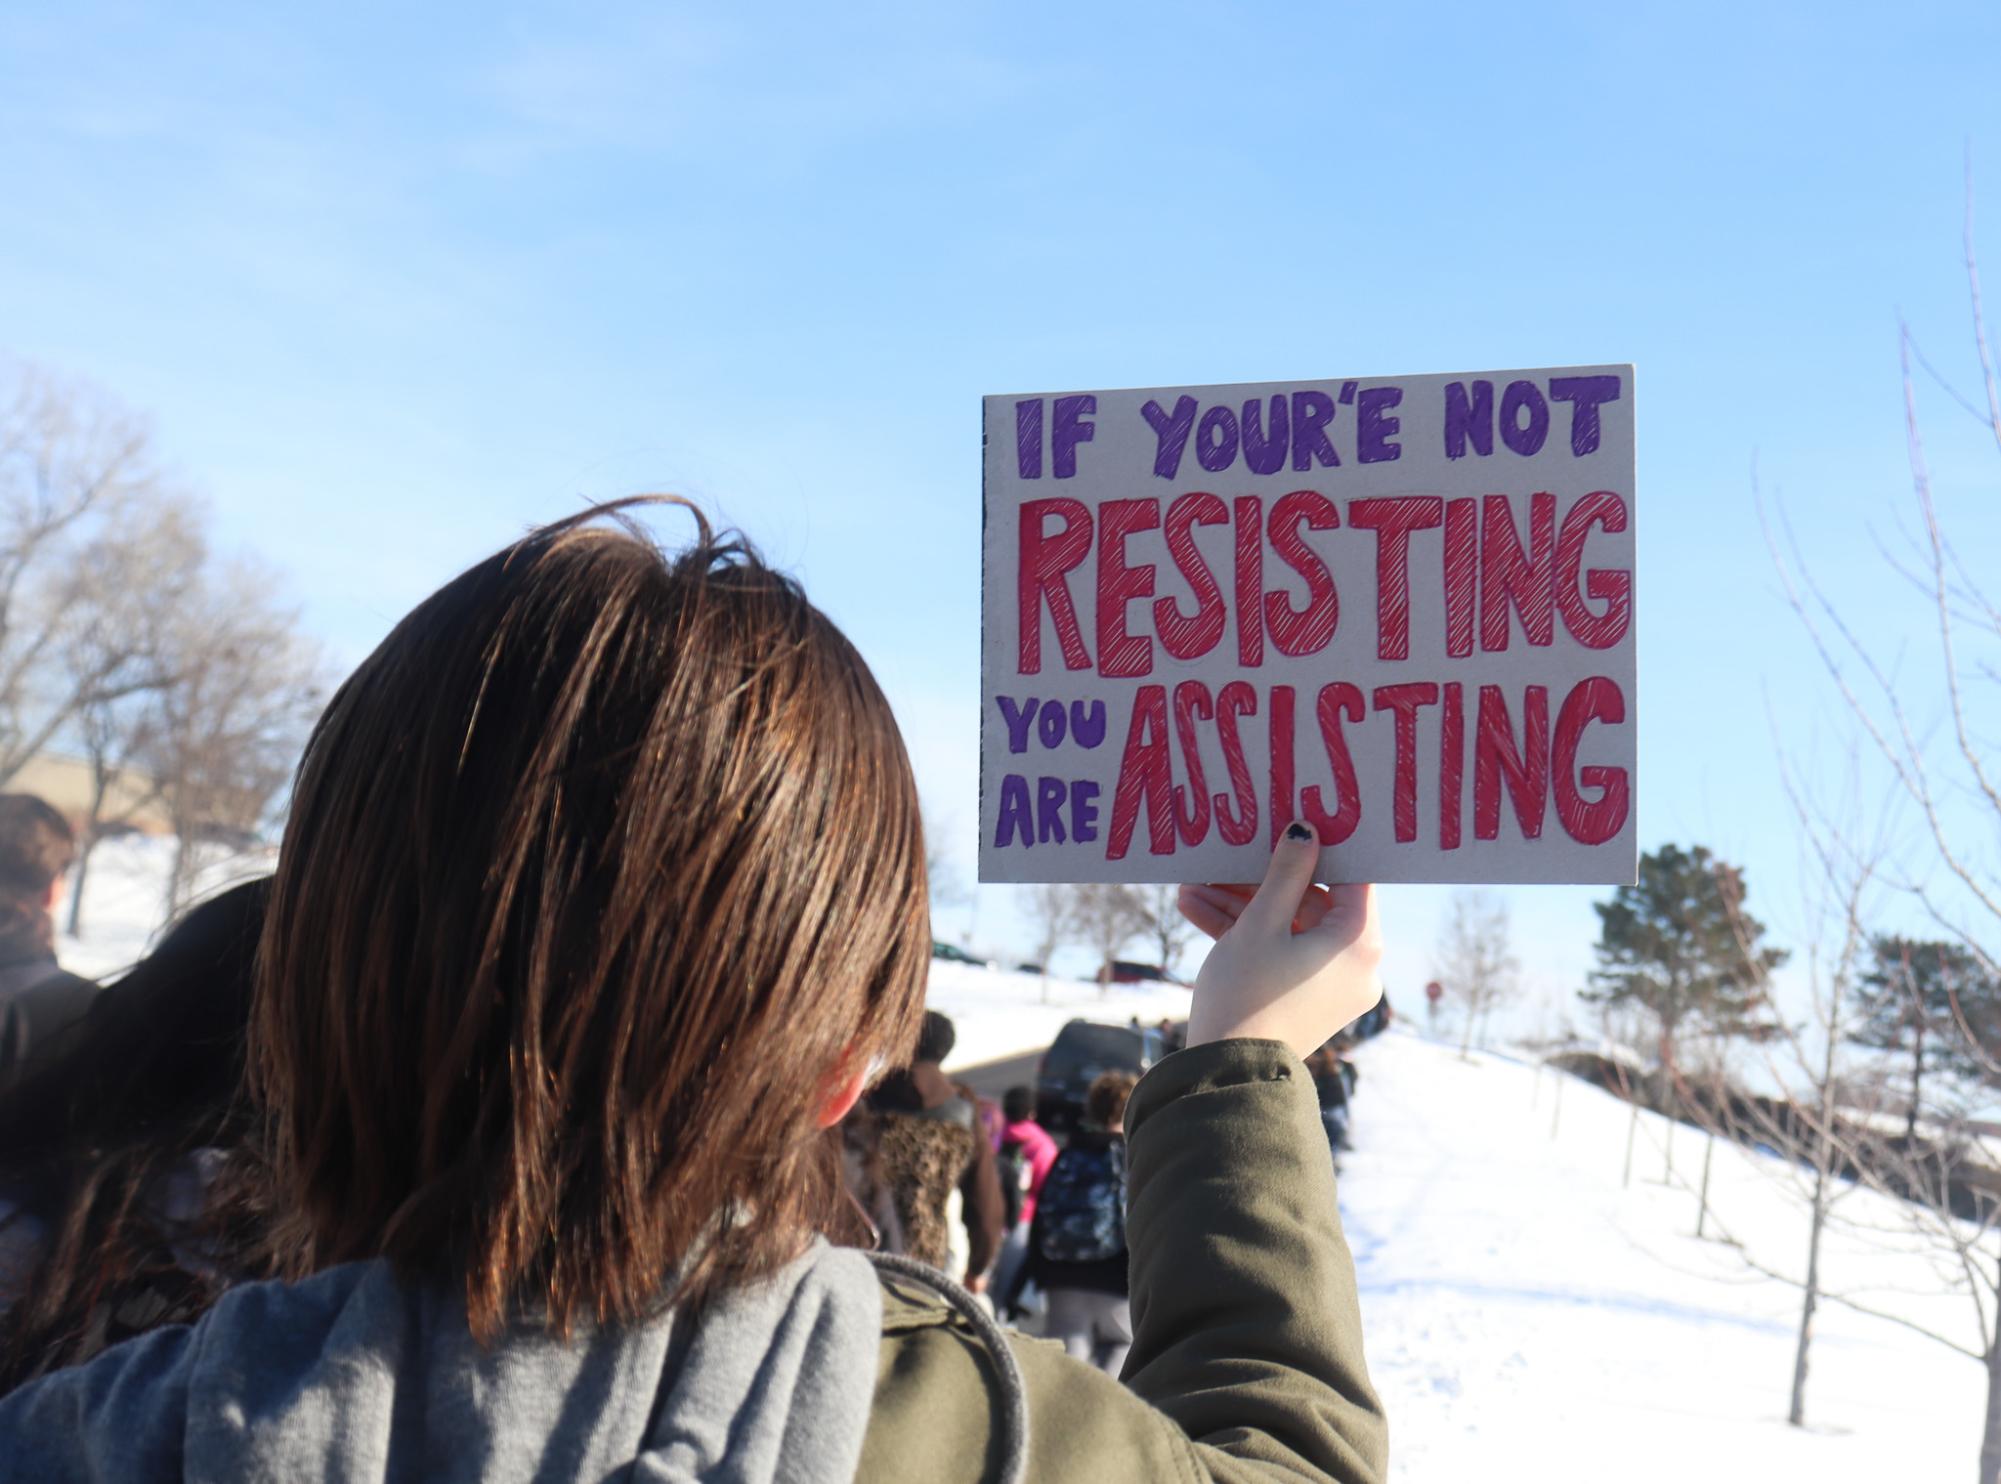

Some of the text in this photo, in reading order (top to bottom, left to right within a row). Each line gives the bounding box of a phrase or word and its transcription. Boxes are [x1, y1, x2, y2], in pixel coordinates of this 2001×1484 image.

[1016, 376, 1620, 480] IF YOUR'E NOT
[1018, 491, 1631, 677] RESISTING
[995, 695, 1106, 753] YOU
[1105, 677, 1629, 860] ASSISTING
[994, 774, 1099, 848] ARE
